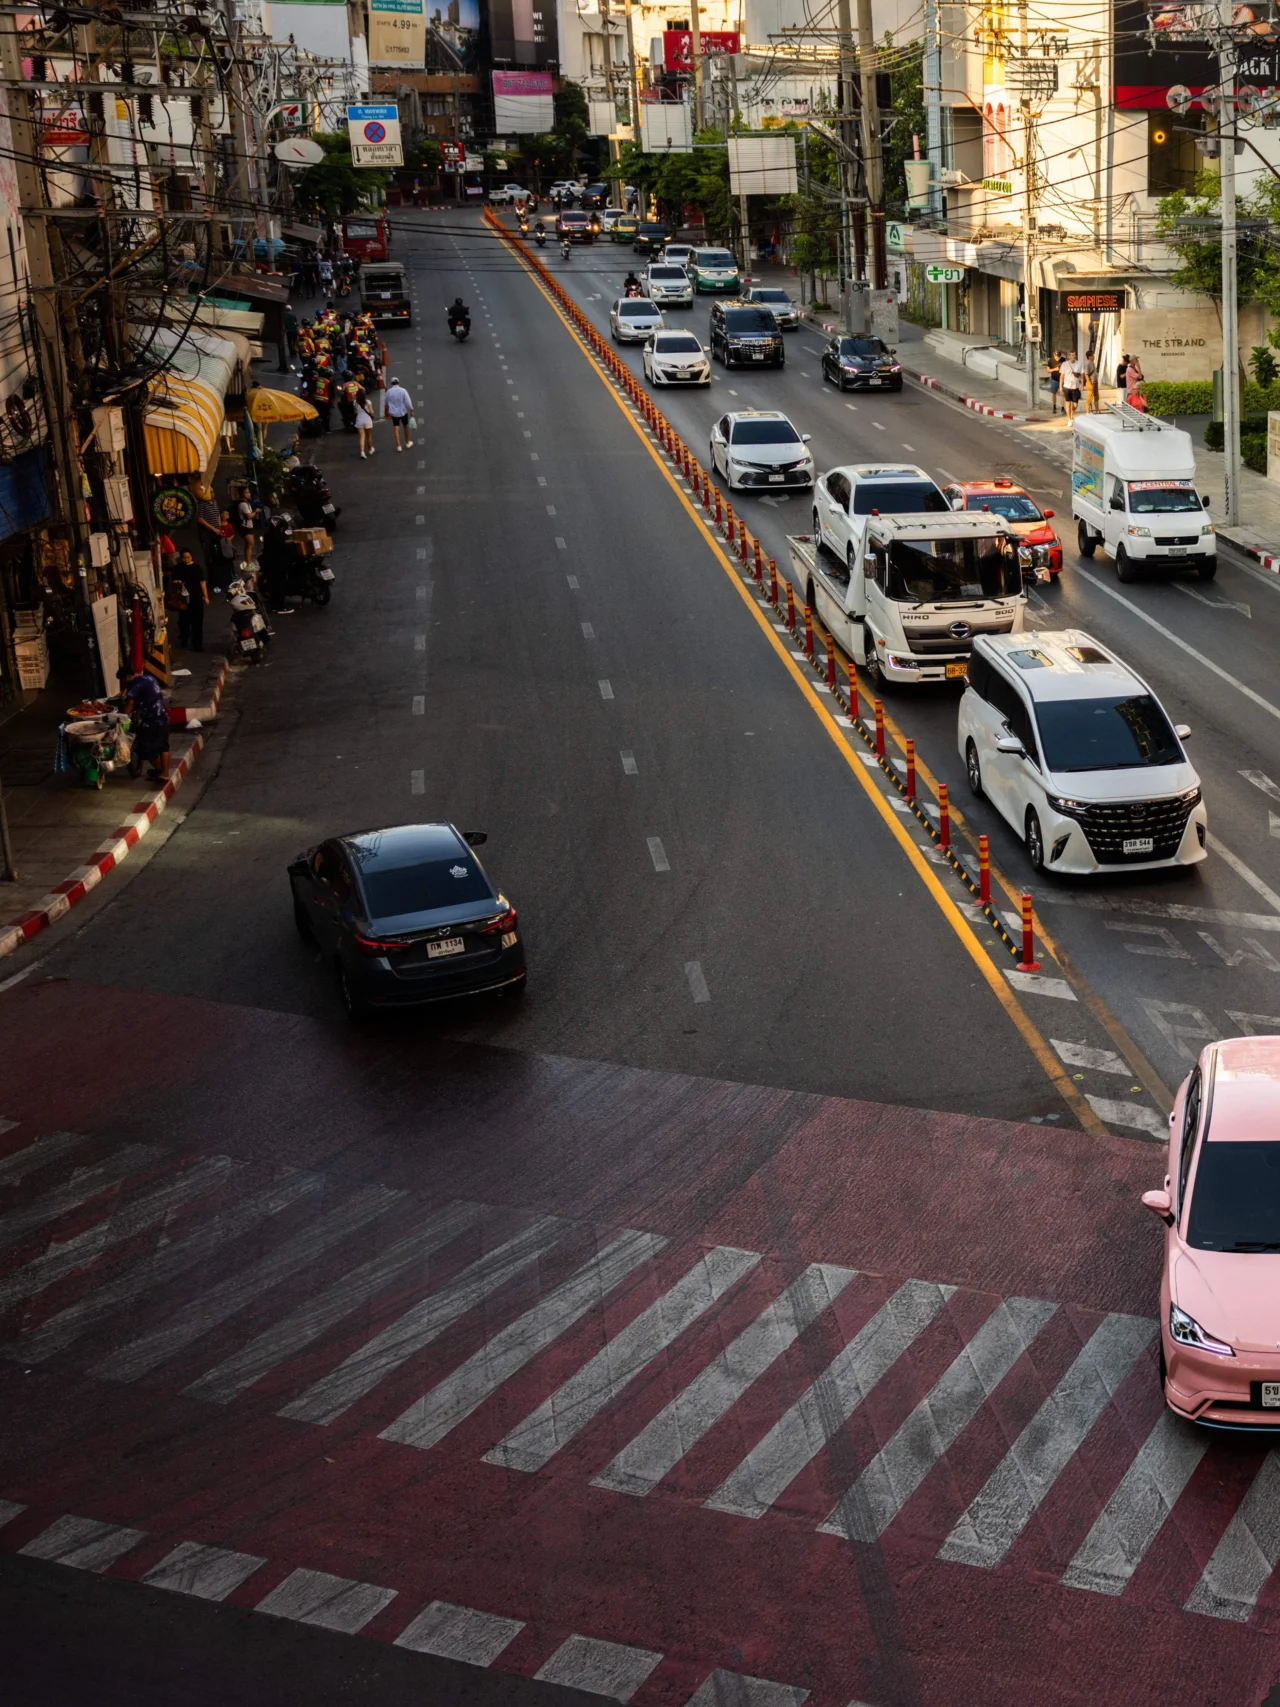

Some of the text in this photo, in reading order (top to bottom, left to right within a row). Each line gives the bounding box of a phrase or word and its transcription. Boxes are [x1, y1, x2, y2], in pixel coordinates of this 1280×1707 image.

[533, 12, 543, 20] WE
[392, 19, 411, 30] 4.99
[1232, 57, 1271, 76] ACK
[944, 269, 960, 280] ยา
[1067, 295, 1118, 308] SIAMESE
[1142, 338, 1206, 348] THE STRAND
[994, 608, 1014, 616] 500
[445, 939, 462, 947] 1134
